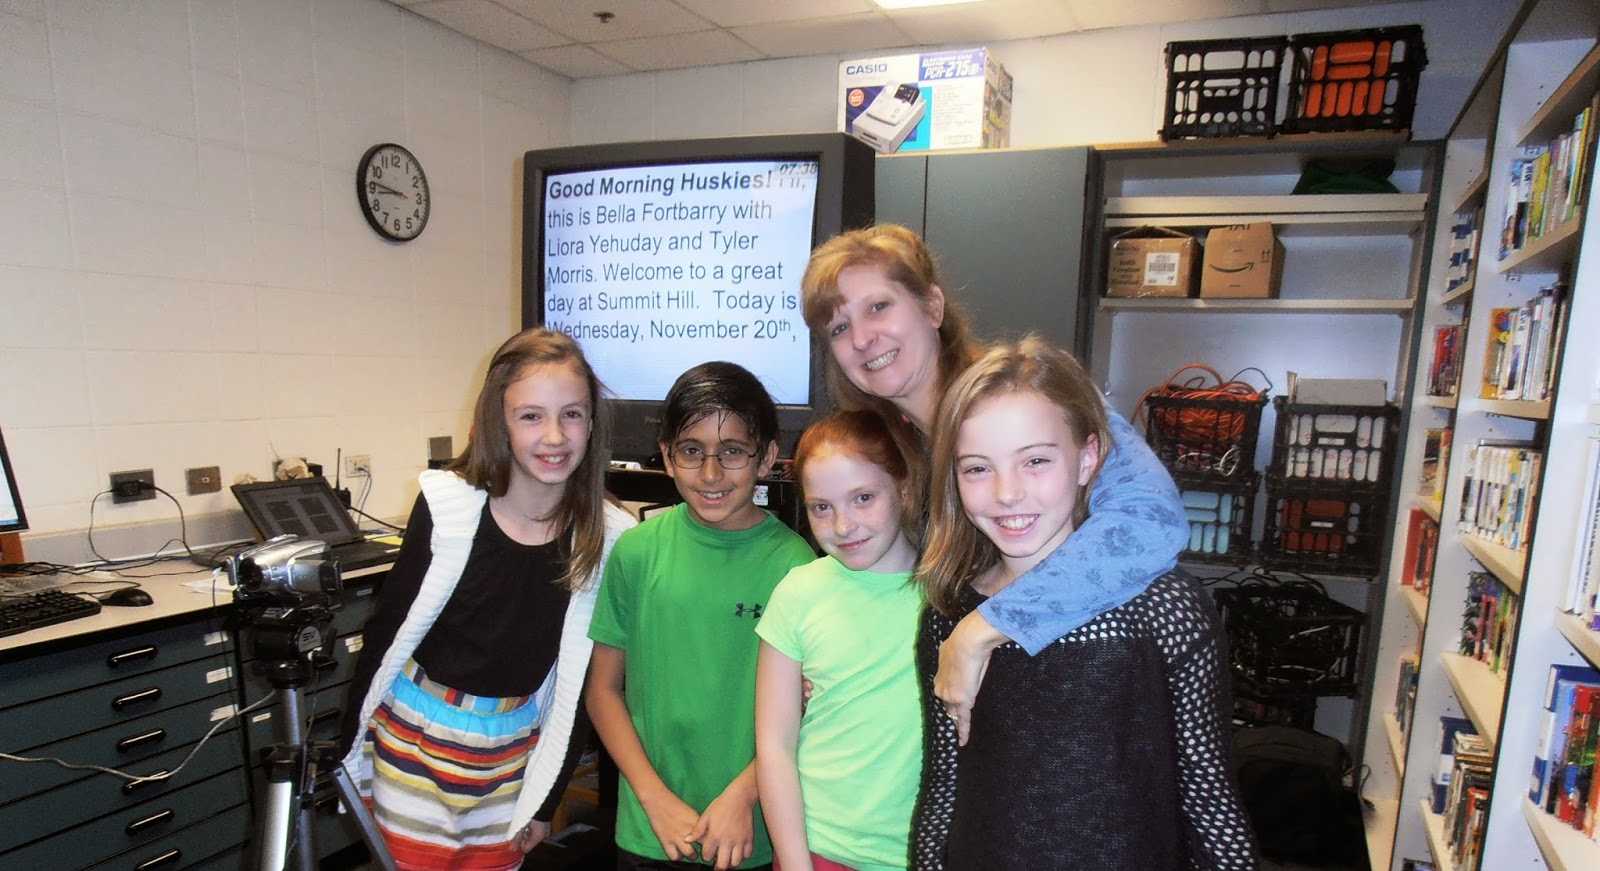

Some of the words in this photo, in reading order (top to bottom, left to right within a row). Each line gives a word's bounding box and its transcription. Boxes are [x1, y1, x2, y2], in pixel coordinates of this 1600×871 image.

[846, 64, 888, 75] CASIO
[381, 156, 389, 168] 11
[391, 155, 401, 168] 12
[372, 165, 382, 179] 10
[369, 181, 376, 194] 9
[413, 176, 419, 188] 2
[549, 178, 594, 199] Good
[600, 175, 674, 197] Morning
[681, 170, 772, 191] Huskies!
[373, 199, 380, 212] 8
[415, 193, 422, 205] 3
[382, 212, 389, 224] 7
[413, 208, 420, 220] 4
[548, 209, 574, 228] this
[579, 207, 591, 225] is
[596, 204, 635, 224] Bella
[642, 202, 727, 225] Fortbarry
[733, 200, 772, 219] with
[394, 219, 401, 231] 6
[405, 218, 413, 229] 5
[548, 239, 584, 257] Liora
[590, 233, 662, 256] Yehuday
[668, 231, 702, 250] and
[709, 230, 758, 254] Tyler
[548, 265, 597, 284] Morris.
[603, 262, 683, 281] Welcome
[689, 262, 706, 280] to
[713, 265, 724, 280] a
[731, 261, 783, 284] great
[548, 294, 574, 316] day
[579, 293, 592, 311] at
[598, 291, 661, 310] Summit
[667, 290, 699, 309] Hill.
[713, 290, 775, 314] Today
[782, 291, 797, 310] is
[651, 320, 748, 338] November
[754, 319, 796, 342] 20th,
